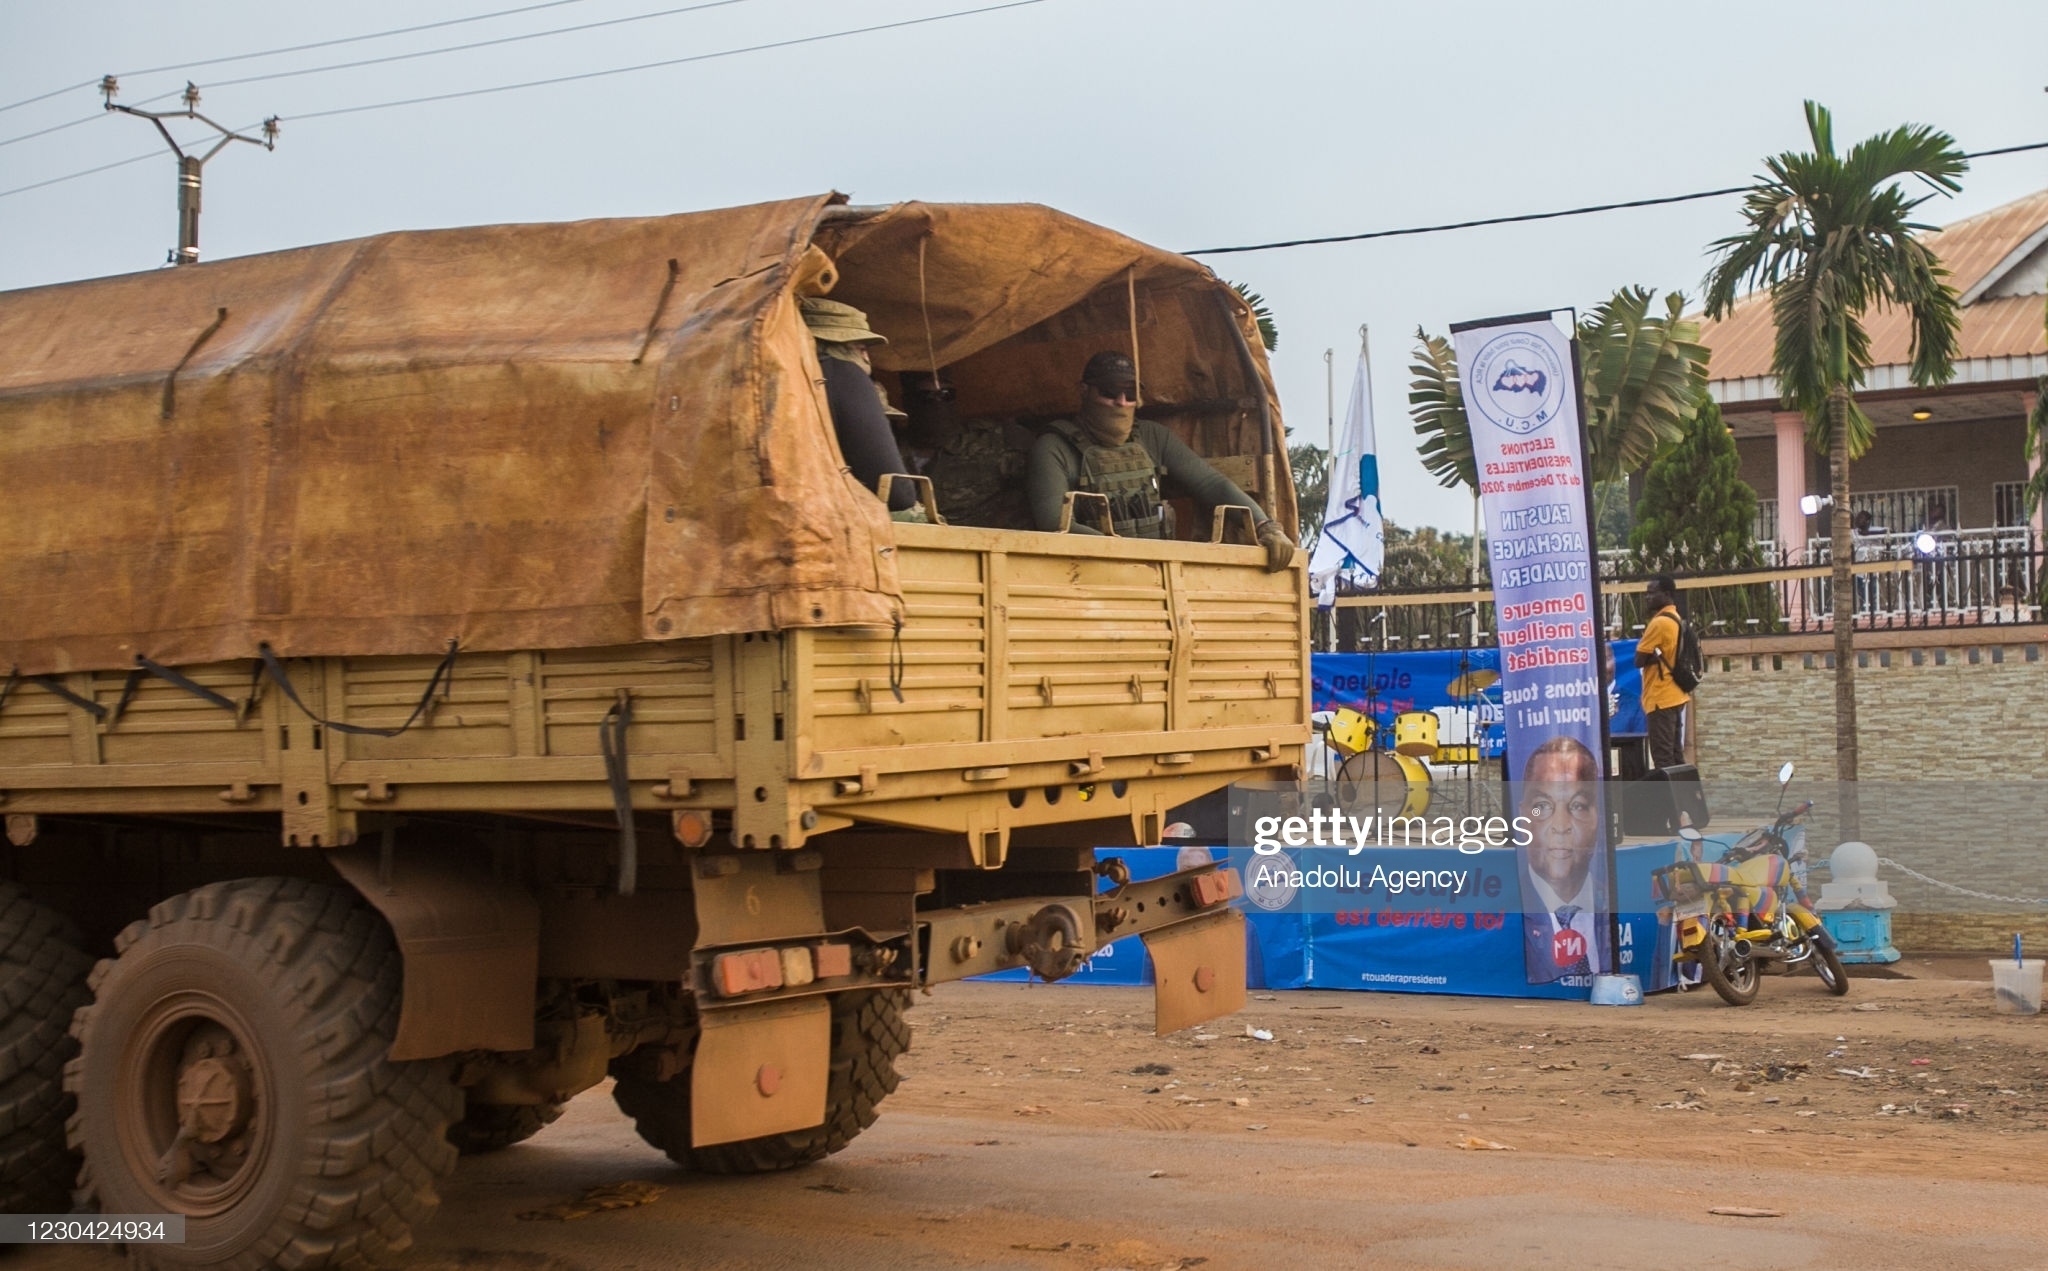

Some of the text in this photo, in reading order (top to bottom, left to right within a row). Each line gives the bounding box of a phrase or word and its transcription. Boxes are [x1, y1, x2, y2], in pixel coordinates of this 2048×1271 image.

[745, 884, 760, 916] 6
[1335, 905, 1506, 931] est derrière toi
